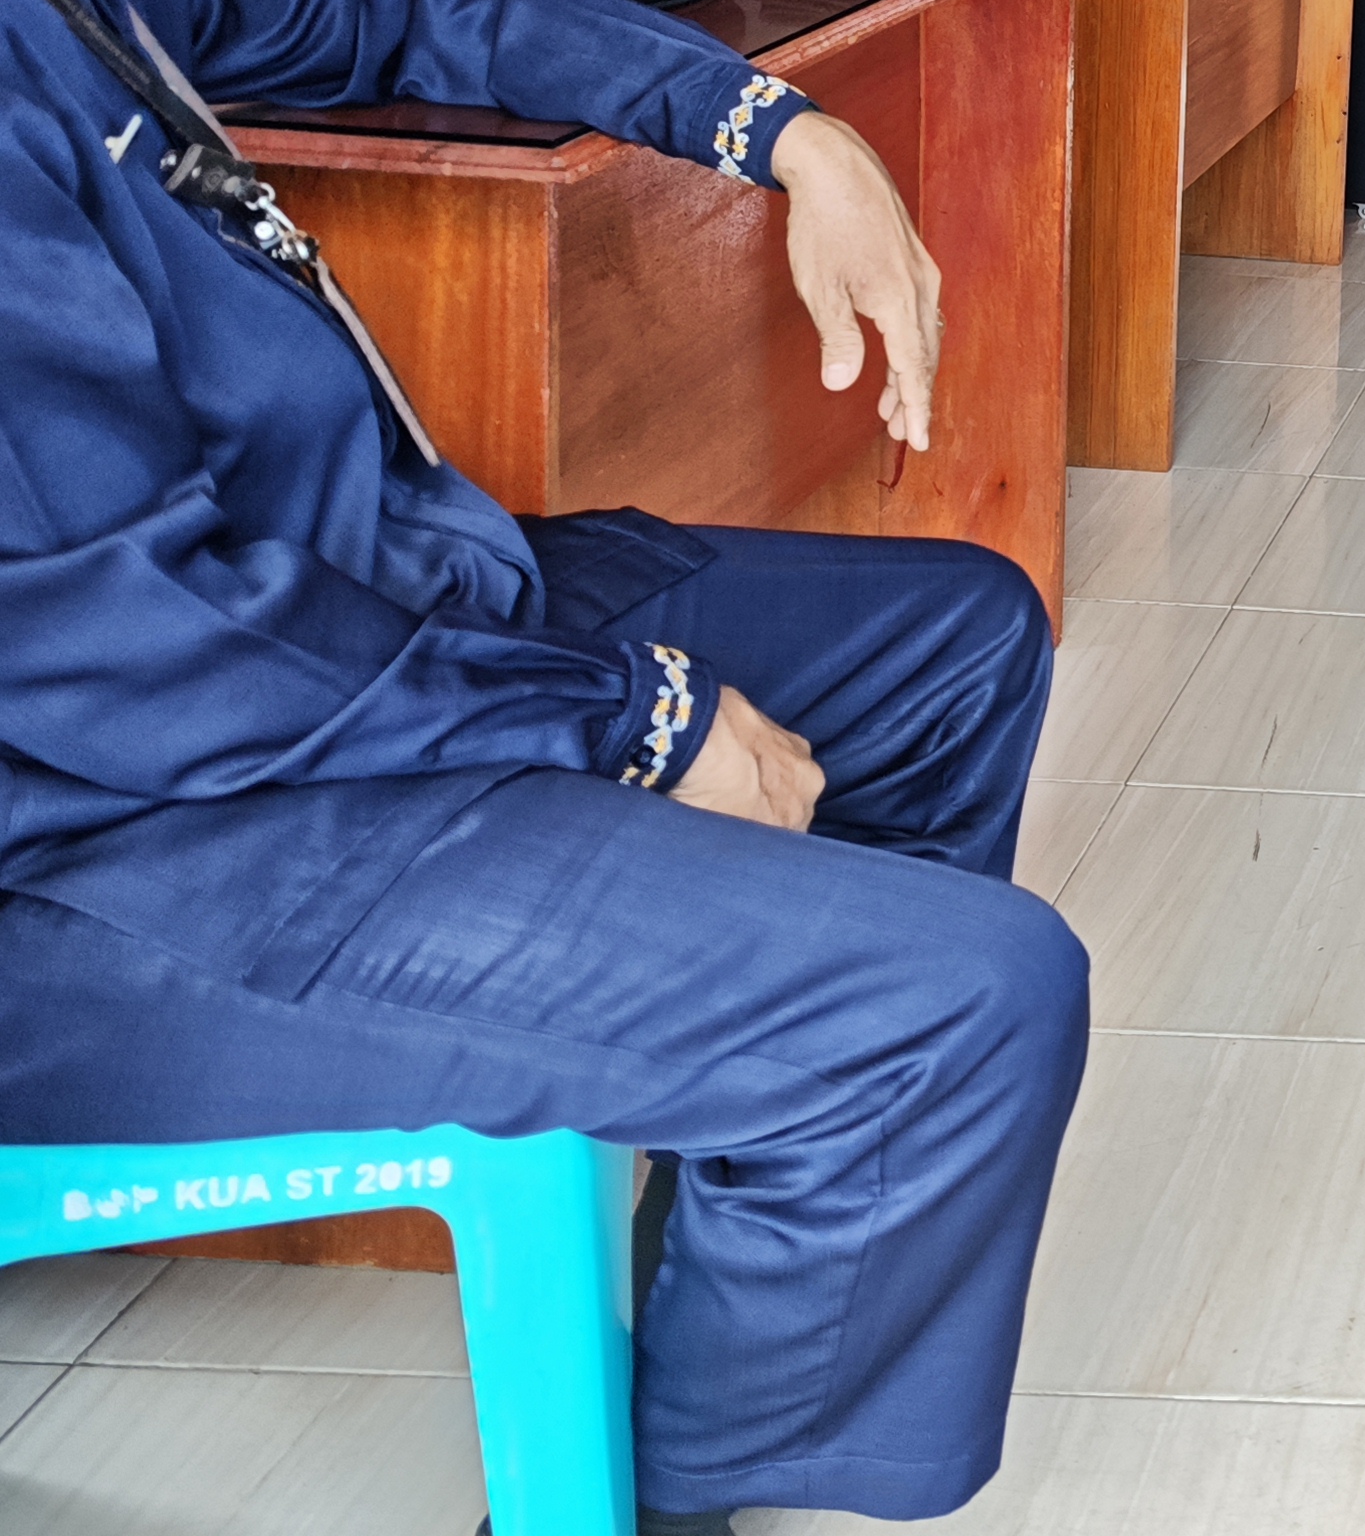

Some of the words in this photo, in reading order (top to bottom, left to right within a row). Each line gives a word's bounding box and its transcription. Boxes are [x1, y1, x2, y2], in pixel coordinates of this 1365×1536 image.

[174, 1173, 272, 1212] KUA
[286, 1165, 343, 1200] ST
[353, 1155, 453, 1196] 2019
